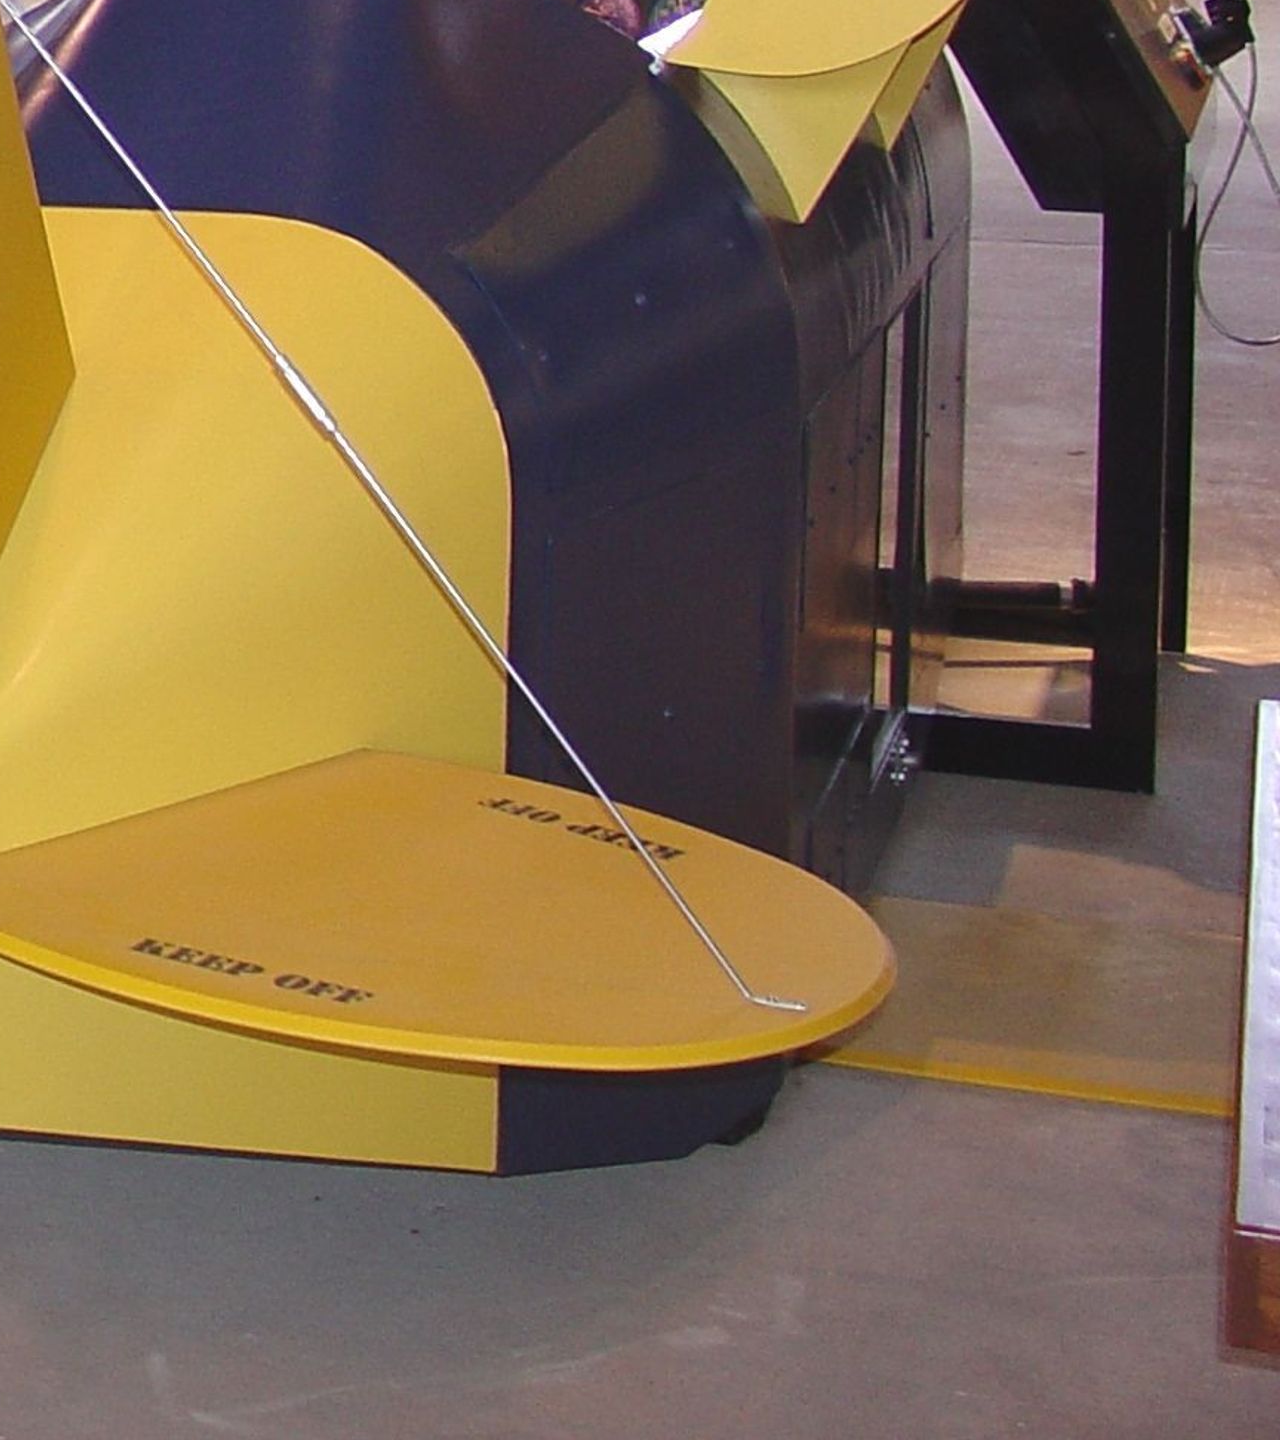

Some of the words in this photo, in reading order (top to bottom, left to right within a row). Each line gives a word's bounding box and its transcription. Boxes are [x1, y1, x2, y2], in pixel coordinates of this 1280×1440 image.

[476, 797, 562, 824] OFF
[564, 823, 687, 861] KEEP
[130, 937, 265, 978] KEEP
[272, 972, 376, 1006] OFF
